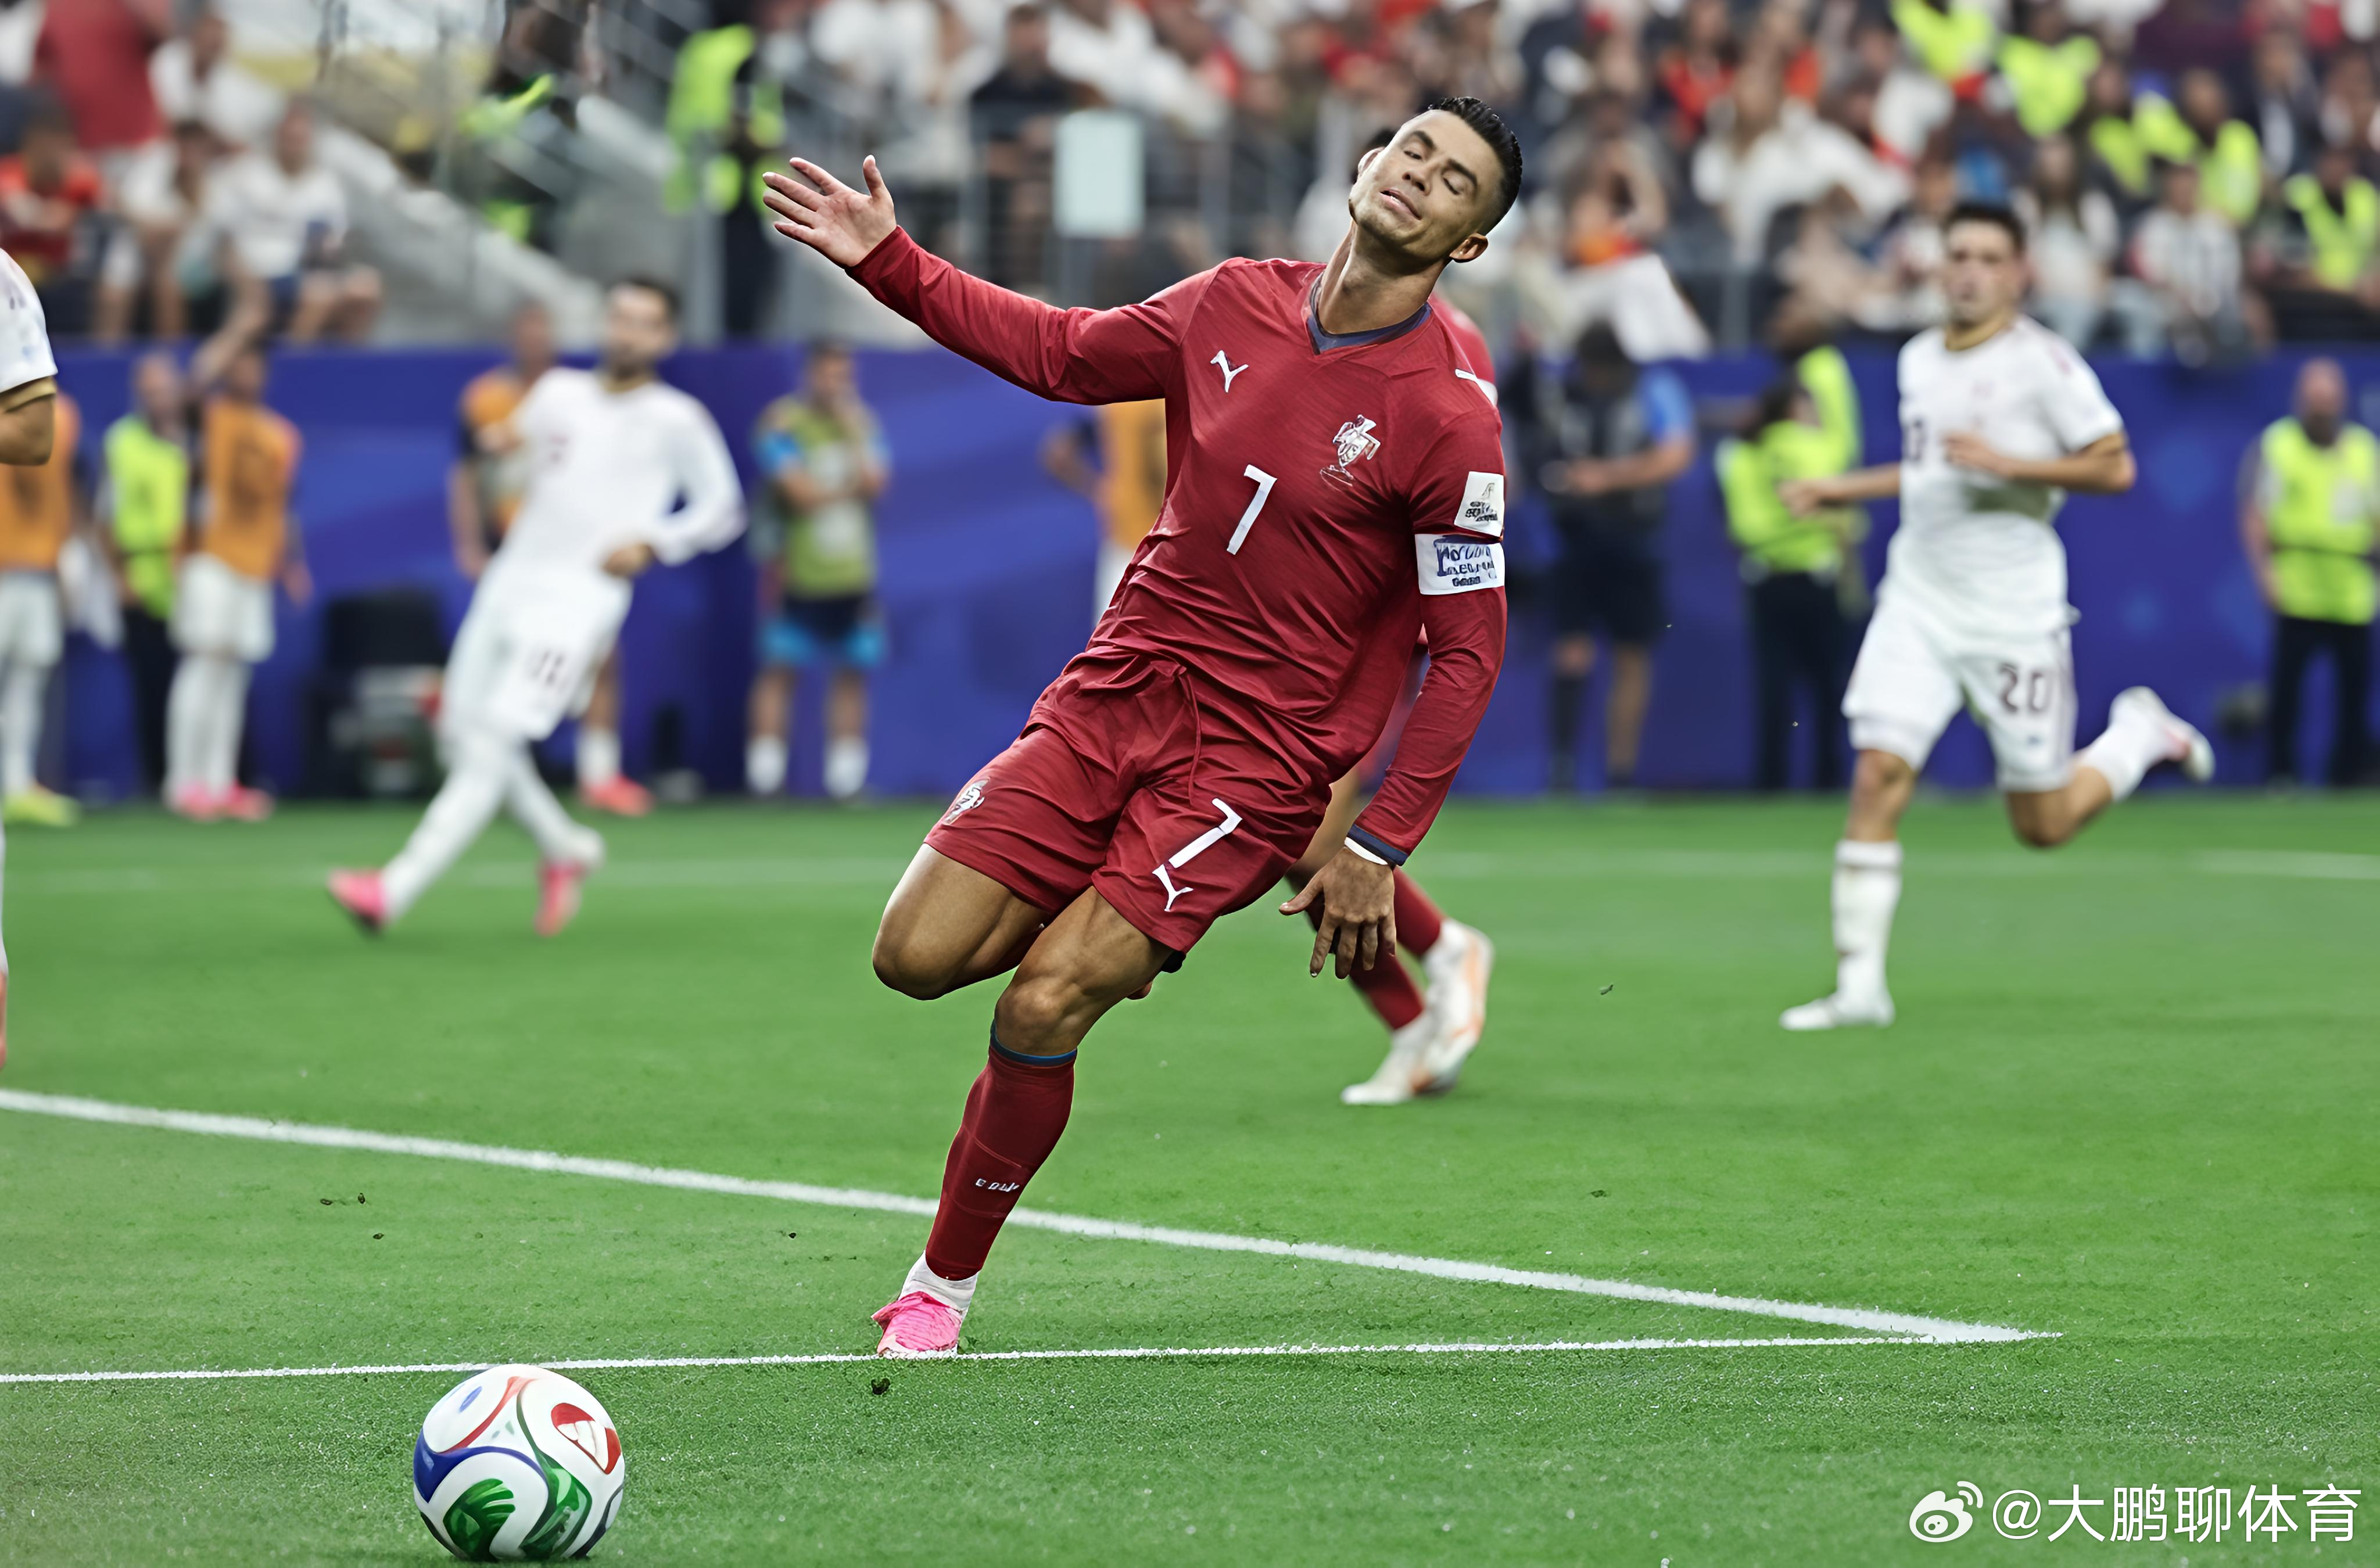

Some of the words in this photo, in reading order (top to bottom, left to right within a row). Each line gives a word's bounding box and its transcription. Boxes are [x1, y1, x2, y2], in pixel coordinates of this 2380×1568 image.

[1226, 464, 1278, 555] 7
[1999, 661, 2051, 713] 20
[1168, 798, 1243, 869] 7
